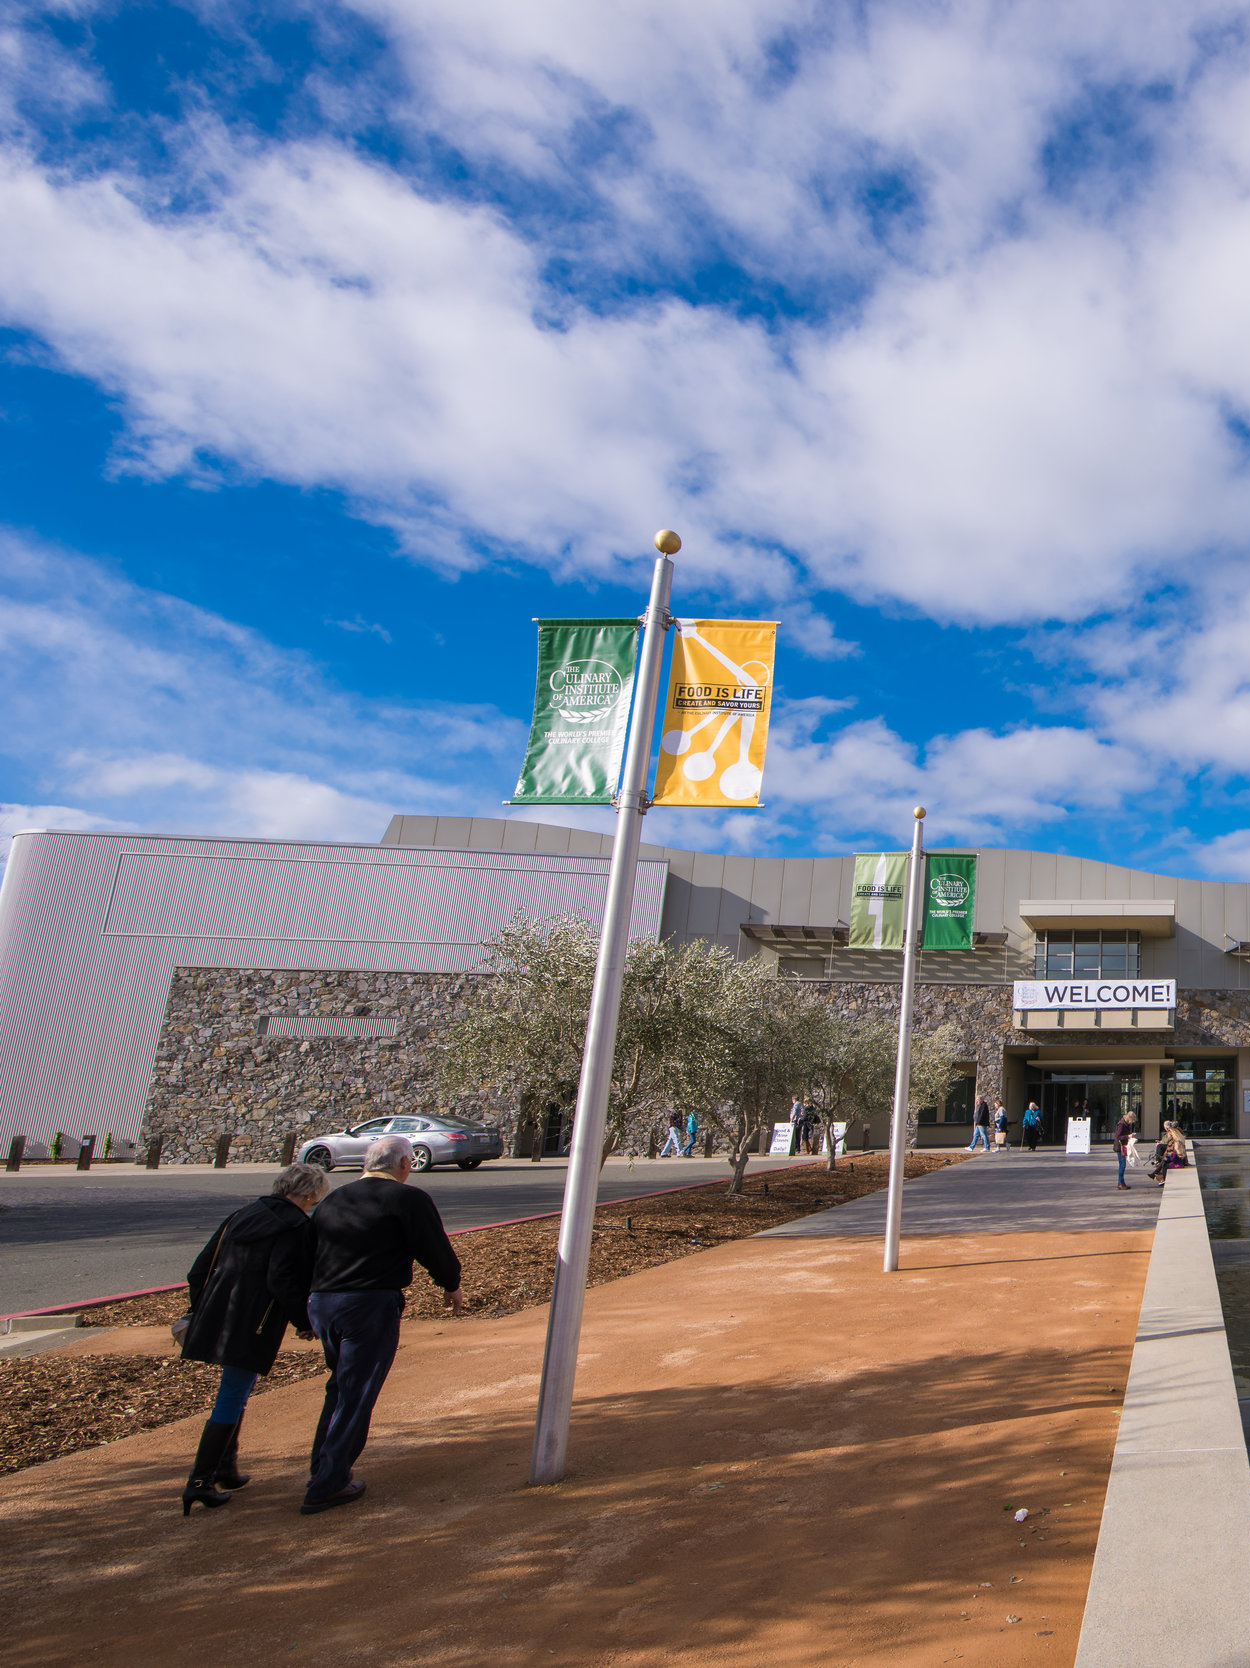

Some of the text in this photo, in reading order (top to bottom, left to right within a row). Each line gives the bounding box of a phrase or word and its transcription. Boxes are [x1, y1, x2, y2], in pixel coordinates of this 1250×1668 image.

[549, 670, 612, 691] CULINARY
[565, 684, 618, 695] INSTITUTE
[678, 686, 763, 699] FOOD IS LIFE
[564, 695, 610, 705] AMERICA
[930, 878, 964, 890] CULINARY
[1044, 985, 1171, 1003] WELCOME!
